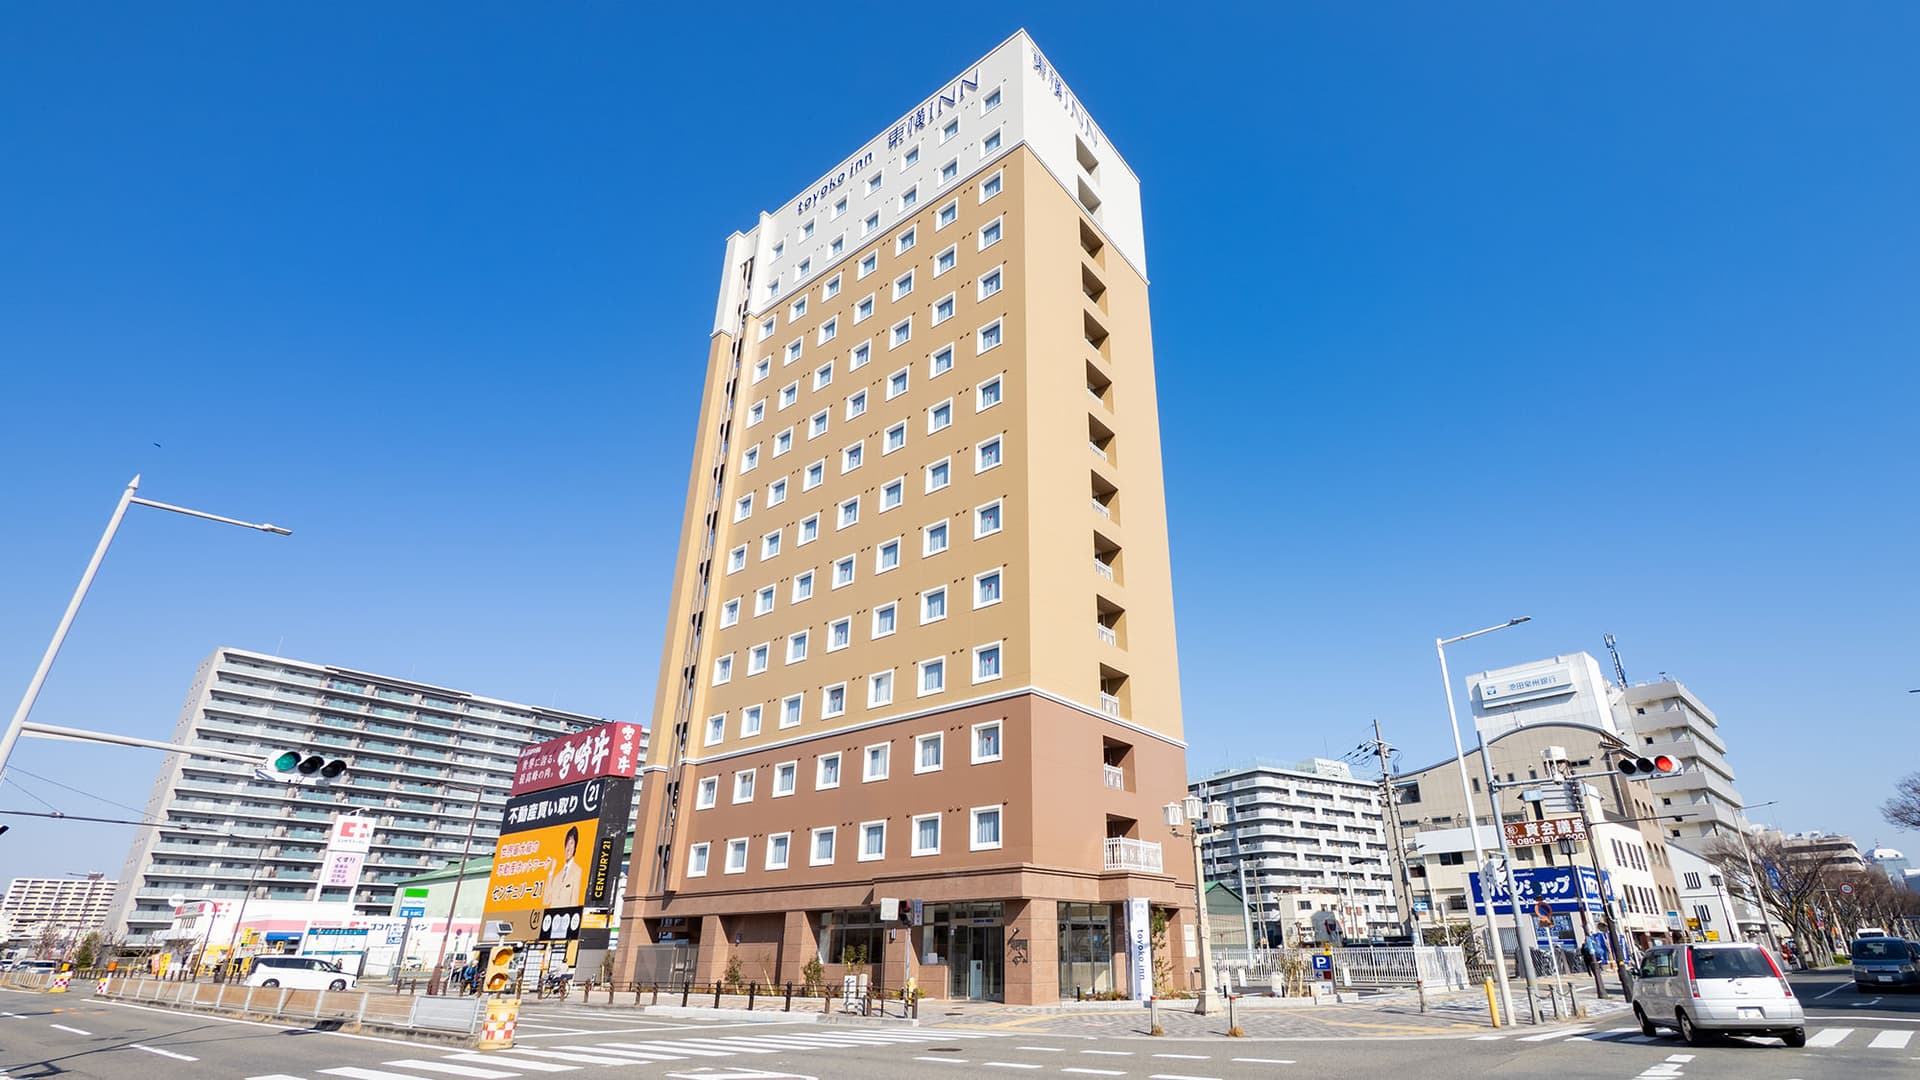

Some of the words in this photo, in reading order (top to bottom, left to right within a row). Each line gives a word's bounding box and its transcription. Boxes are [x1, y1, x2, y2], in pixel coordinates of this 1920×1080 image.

[888, 69, 979, 149] 東横INN
[798, 172, 845, 215] toyoko
[849, 152, 873, 176] inn
[558, 729, 610, 779] 宮崎牛
[618, 725, 635, 774] 宮崎牛
[508, 796, 578, 824] 不動産買い取り
[336, 856, 356, 864] くすり
[594, 851, 609, 899] CENTURY
[604, 840, 611, 852] 21
[493, 881, 544, 900] センチュリー21
[1136, 929, 1145, 962] toyoko
[1316, 957, 1326, 968] P
